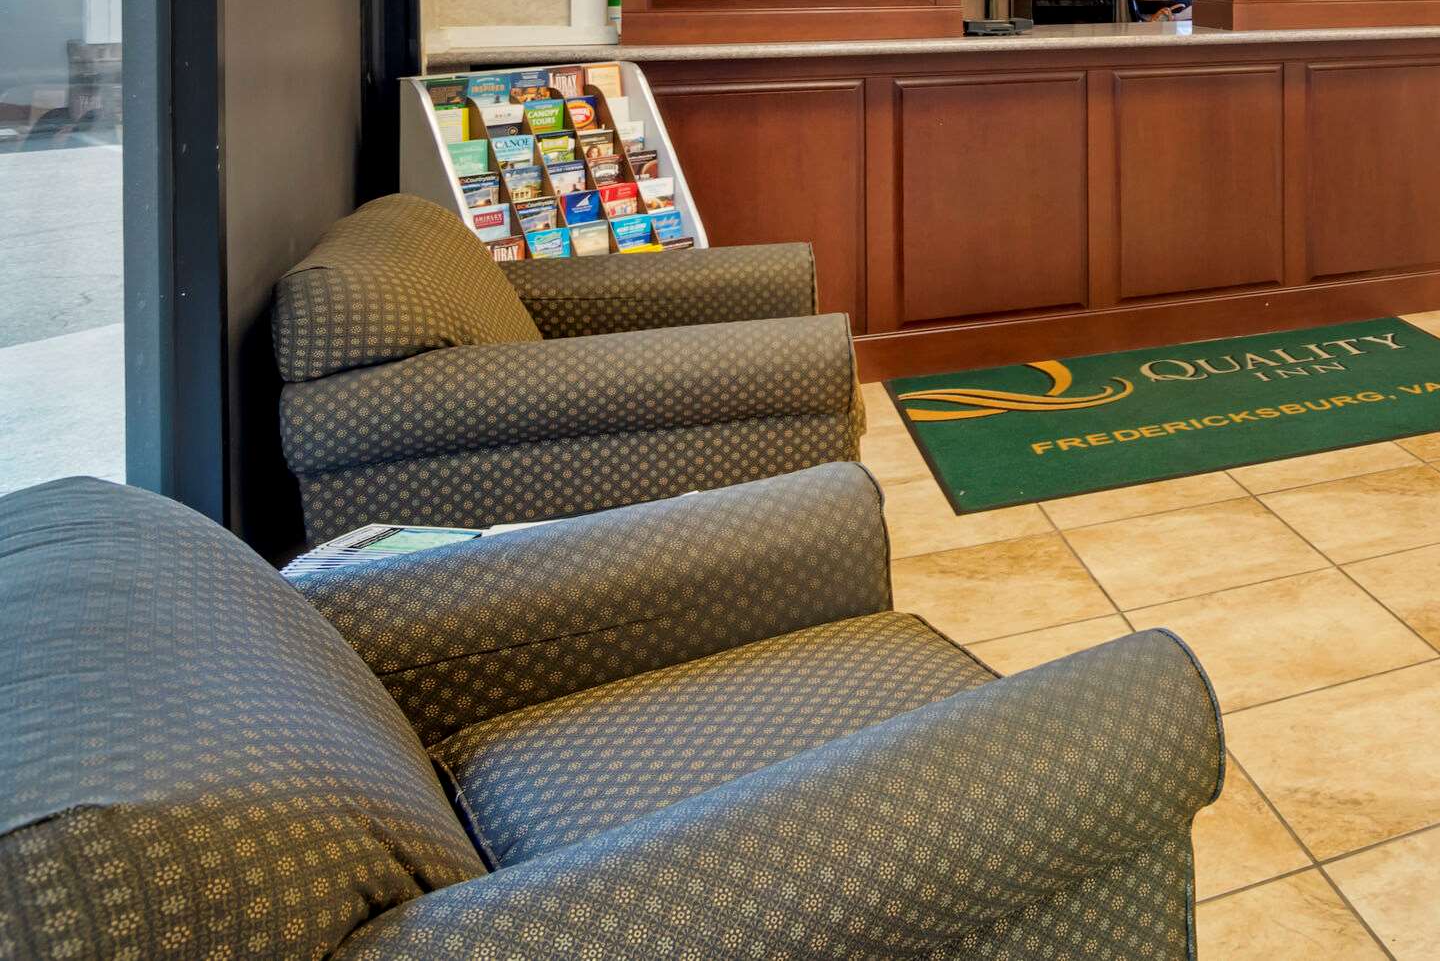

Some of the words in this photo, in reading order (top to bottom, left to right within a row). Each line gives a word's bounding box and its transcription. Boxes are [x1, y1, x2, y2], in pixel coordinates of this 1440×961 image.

[528, 108, 560, 119] CANOPY
[532, 117, 556, 126] TOURS
[1139, 333, 1407, 382] QUALITY
[1252, 361, 1347, 382] INN
[1031, 390, 1398, 455] FREDERICKSBURG,
